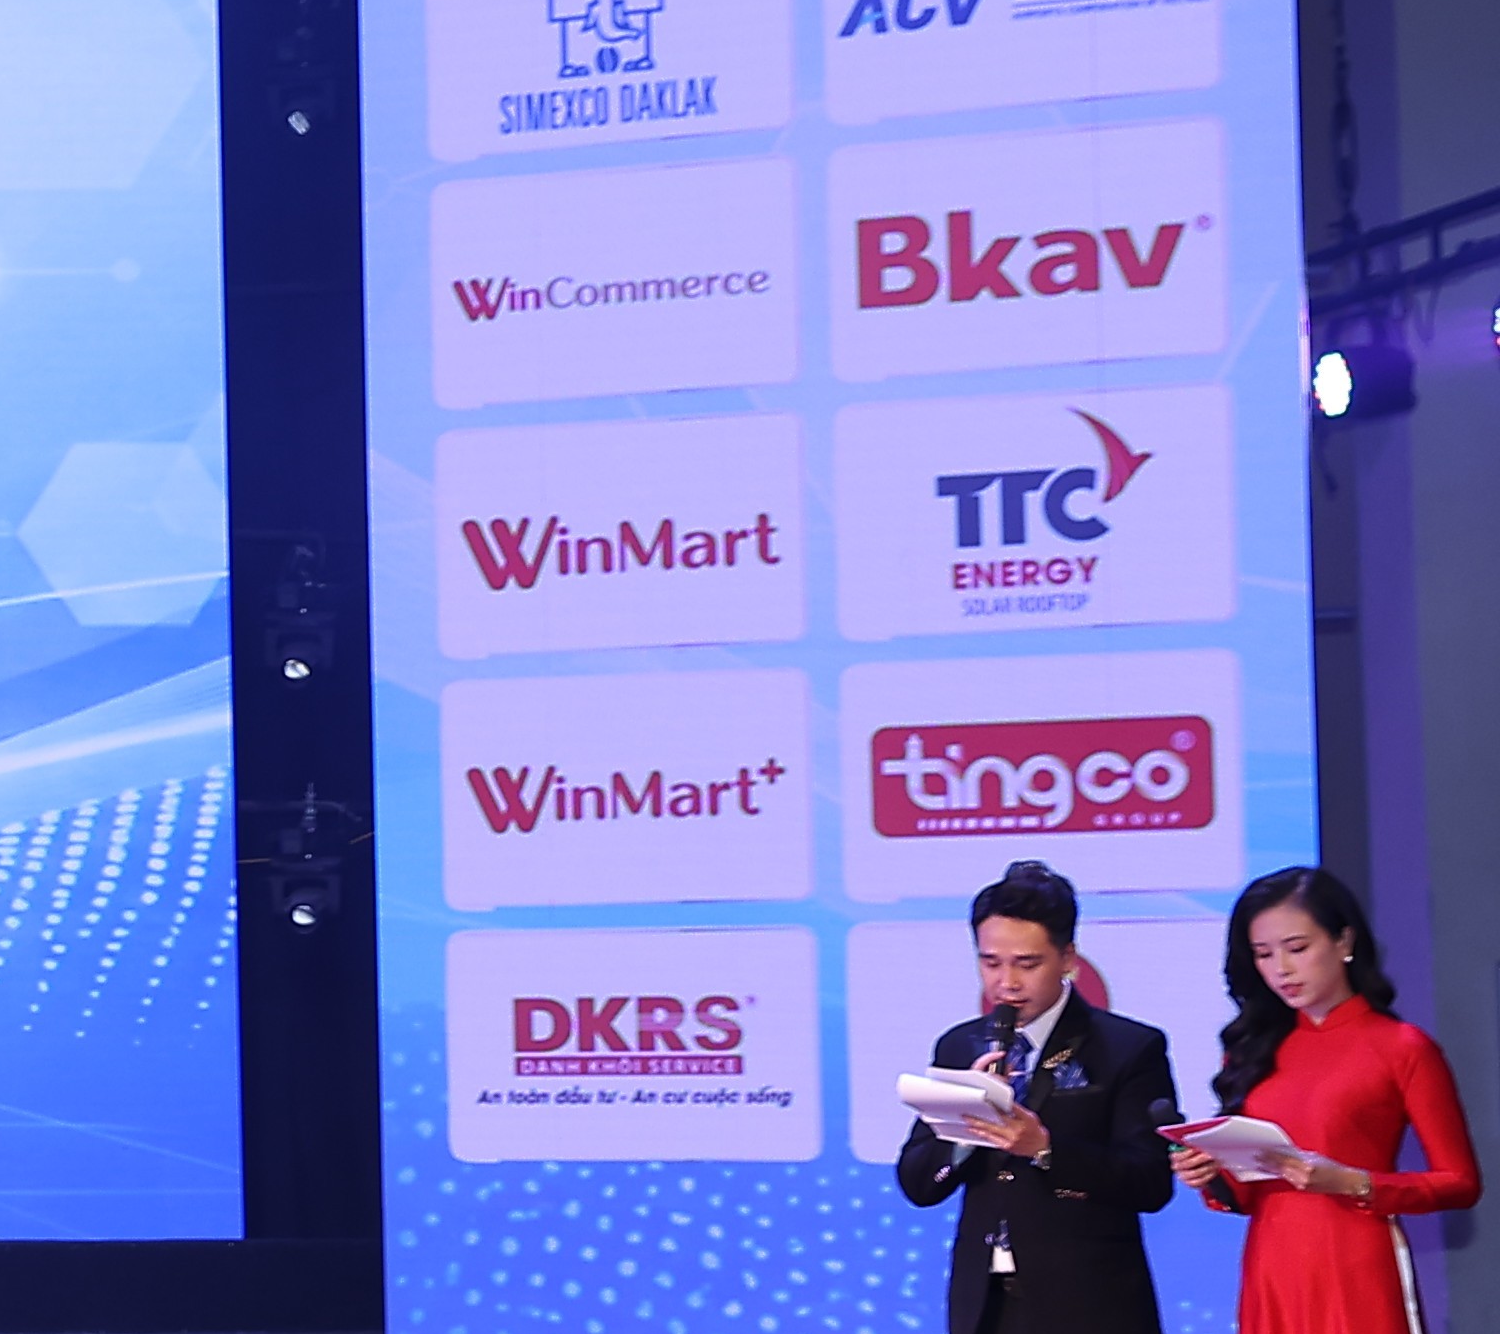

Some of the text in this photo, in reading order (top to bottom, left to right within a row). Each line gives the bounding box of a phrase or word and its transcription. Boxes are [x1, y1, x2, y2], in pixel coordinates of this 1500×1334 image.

[500, 76, 717, 134] SIMEXCO DAKLAK
[856, 210, 1186, 310] Bkav
[454, 269, 771, 323] WinCommerce
[937, 468, 1110, 547] TTC
[462, 513, 782, 592] WinMart
[954, 557, 1097, 589] ENERGY
[963, 596, 1009, 616] SOLAR
[881, 734, 1190, 828] tingco
[514, 996, 742, 1052] DKRS
[520, 1059, 581, 1074] DANH
[649, 1058, 736, 1073] SERVICE
